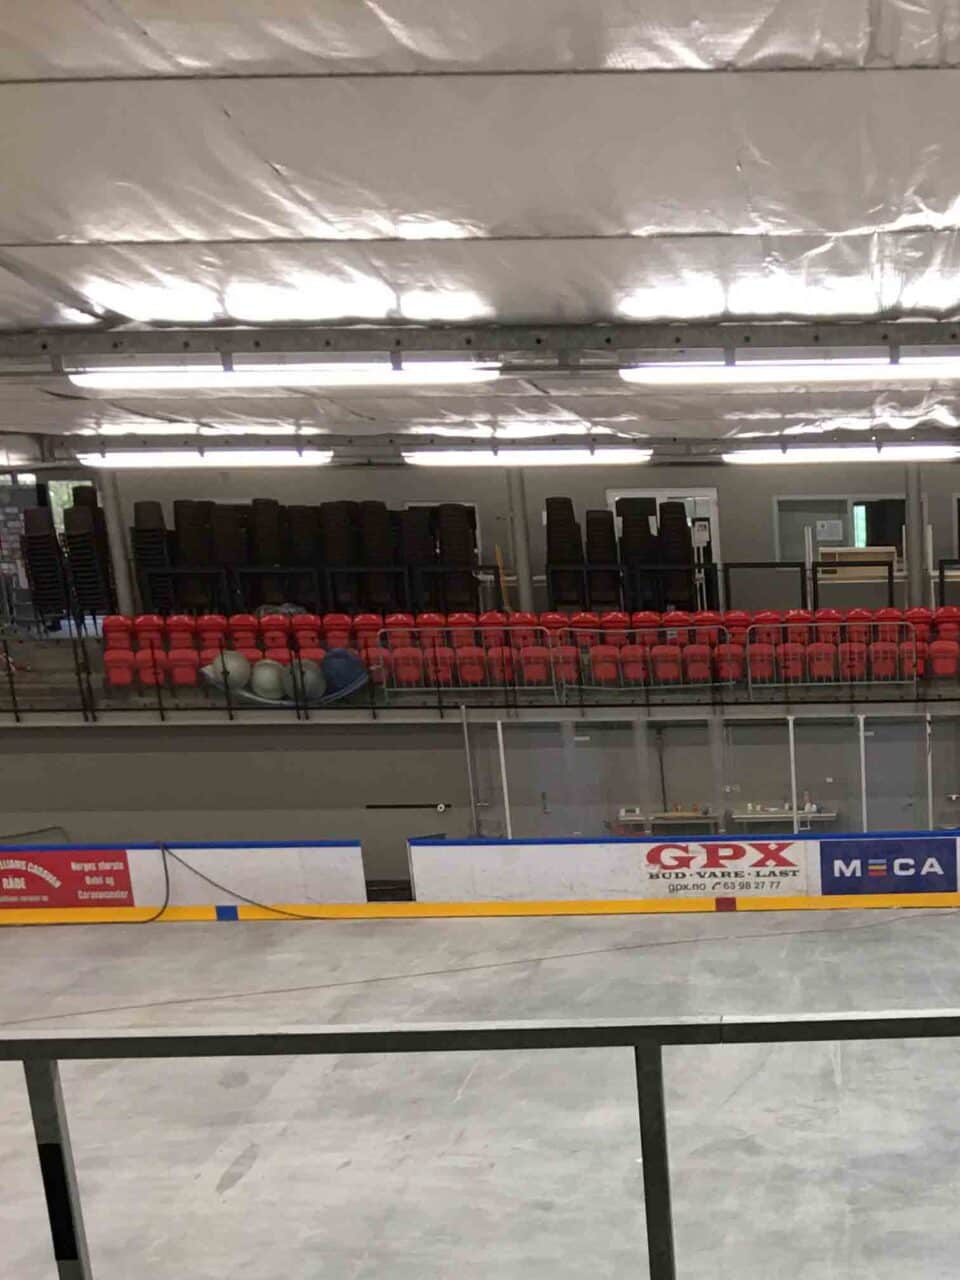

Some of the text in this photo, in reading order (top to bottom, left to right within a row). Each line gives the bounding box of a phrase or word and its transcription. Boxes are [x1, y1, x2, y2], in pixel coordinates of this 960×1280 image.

[646, 842, 798, 870] GPX
[668, 881, 781, 894] gpx.no 63 98 27 77
